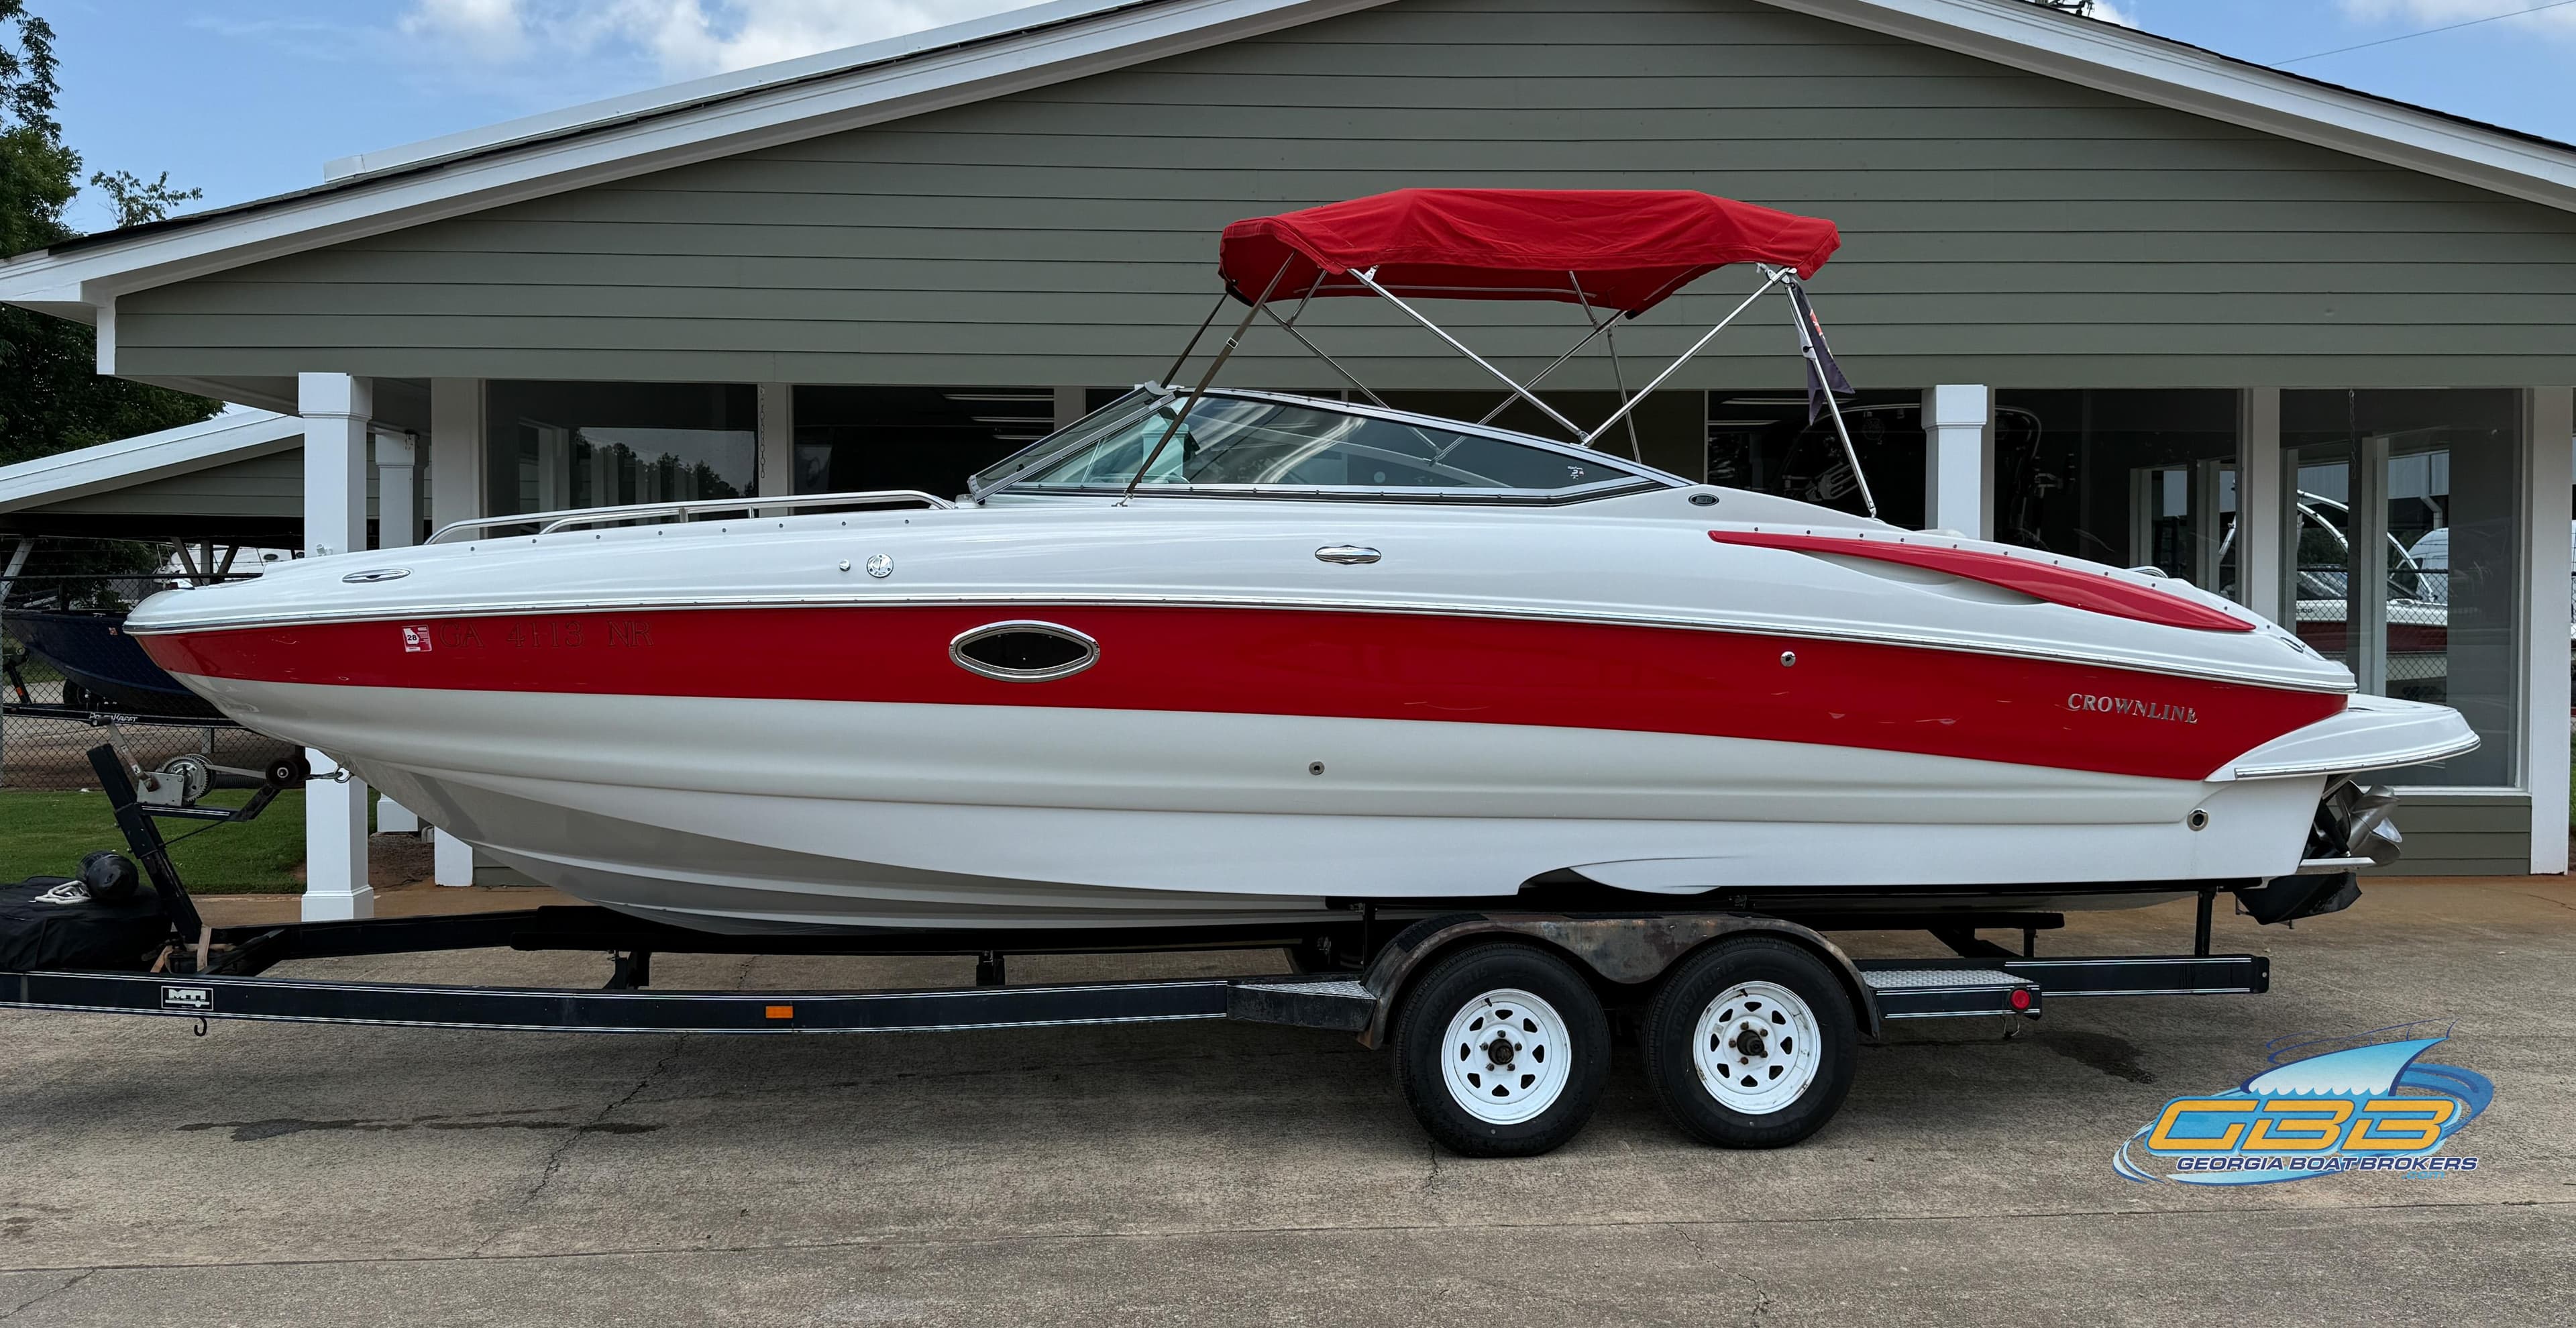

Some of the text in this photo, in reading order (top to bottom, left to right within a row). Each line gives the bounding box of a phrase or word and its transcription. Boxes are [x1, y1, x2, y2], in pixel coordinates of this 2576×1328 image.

[439, 621, 484, 648] GA
[606, 619, 655, 647] NR
[2067, 693, 2198, 725] CROWNLINE
